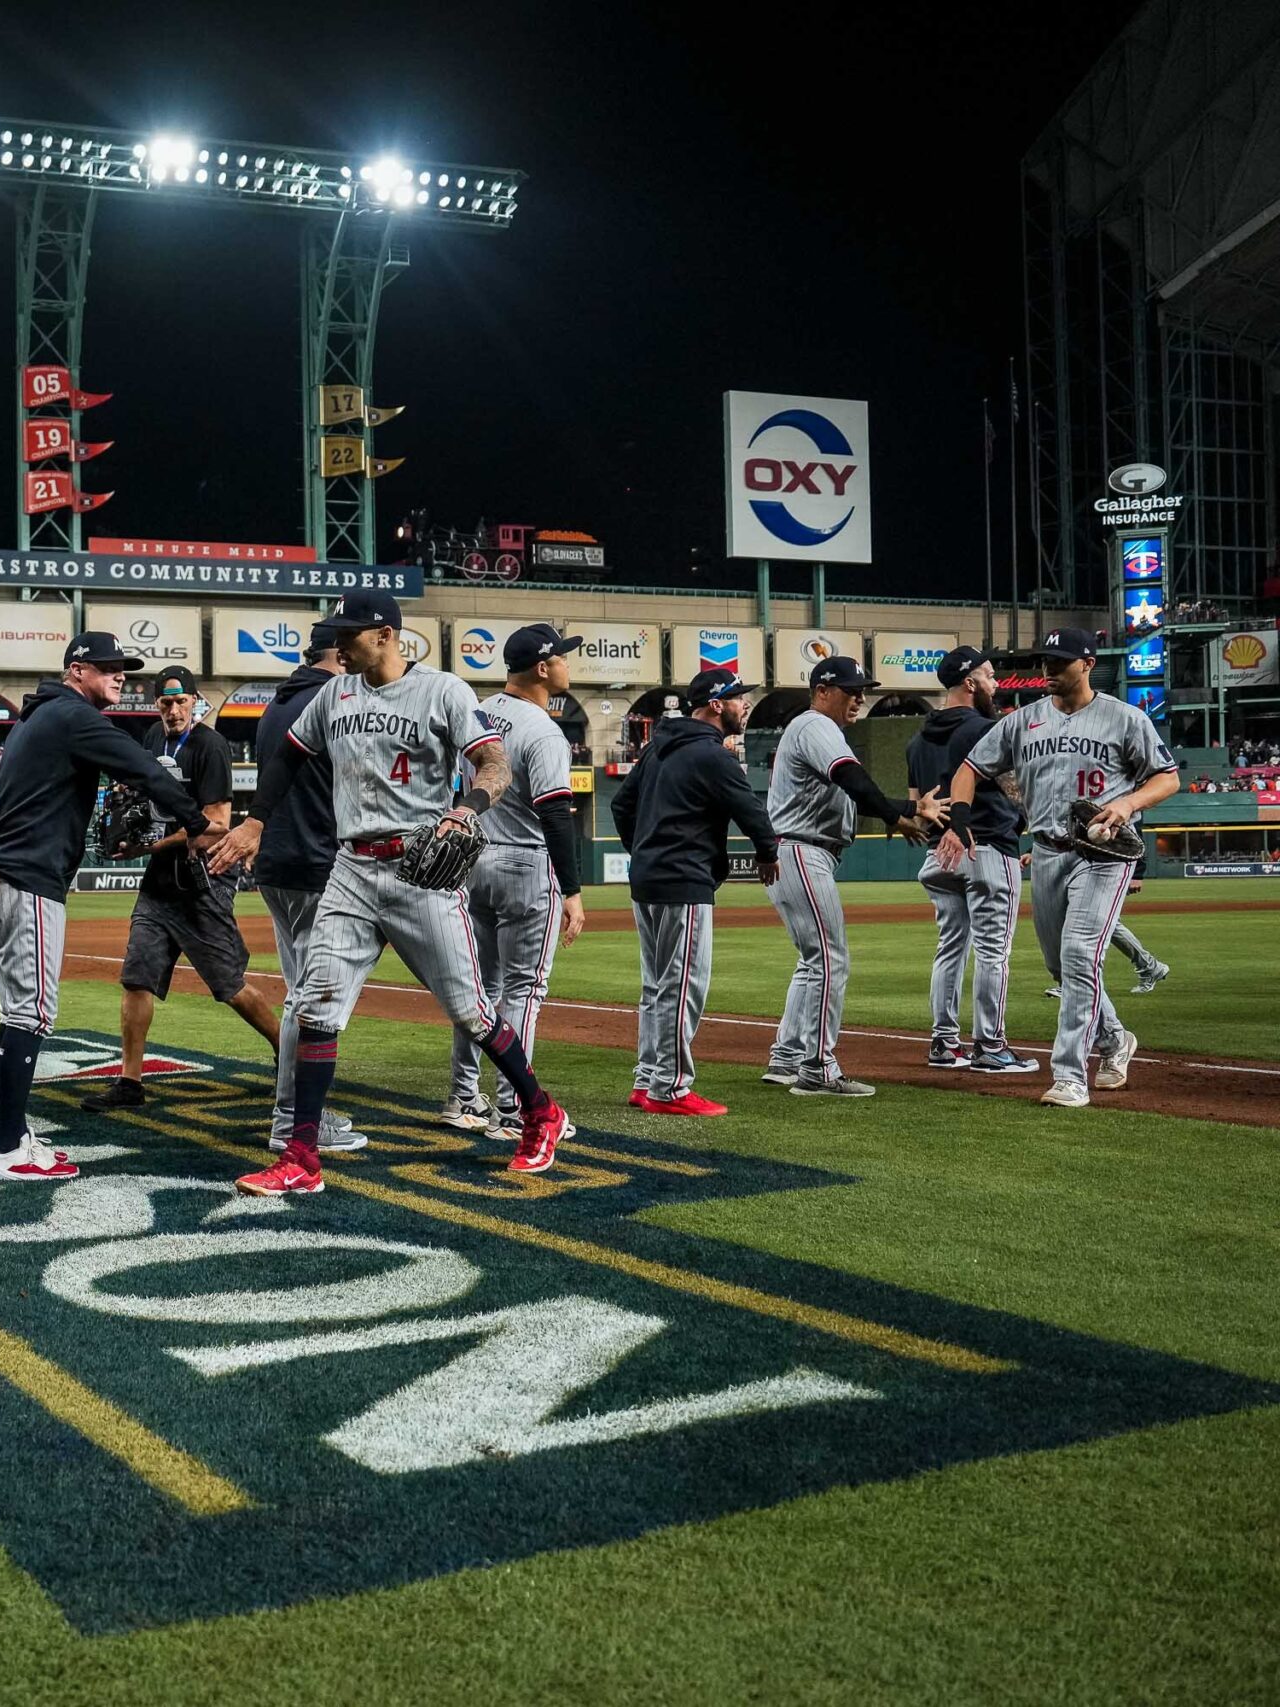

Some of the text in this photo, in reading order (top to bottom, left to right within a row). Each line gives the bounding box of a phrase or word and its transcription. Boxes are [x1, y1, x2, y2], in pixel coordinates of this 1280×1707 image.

[33, 373, 61, 395] 05
[330, 393, 354, 413] 17
[35, 428, 62, 449] 19
[331, 447, 355, 465] 22
[743, 457, 857, 496] OXY
[34, 479, 60, 500] 21
[1094, 495, 1183, 513] Gallagher
[1102, 511, 1176, 526] INSURANCE
[123, 542, 284, 558] MINUTE MAID
[110, 563, 279, 584] COMMUNITY
[292, 570, 405, 589] LEADERS
[262, 623, 301, 648] slb
[699, 629, 738, 641] Chevron
[1046, 634, 1060, 646] M
[122, 646, 188, 659] EXUS
[460, 643, 496, 654] OXY
[578, 638, 641, 659] reliant
[883, 655, 941, 666] FREEPORT
[232, 693, 273, 704] Crawfor
[547, 697, 567, 711] CITY
[330, 711, 421, 746] MINNESOTA
[1021, 735, 1110, 766] MINNESOTA
[389, 751, 412, 786] 4
[1076, 769, 1106, 797] 19
